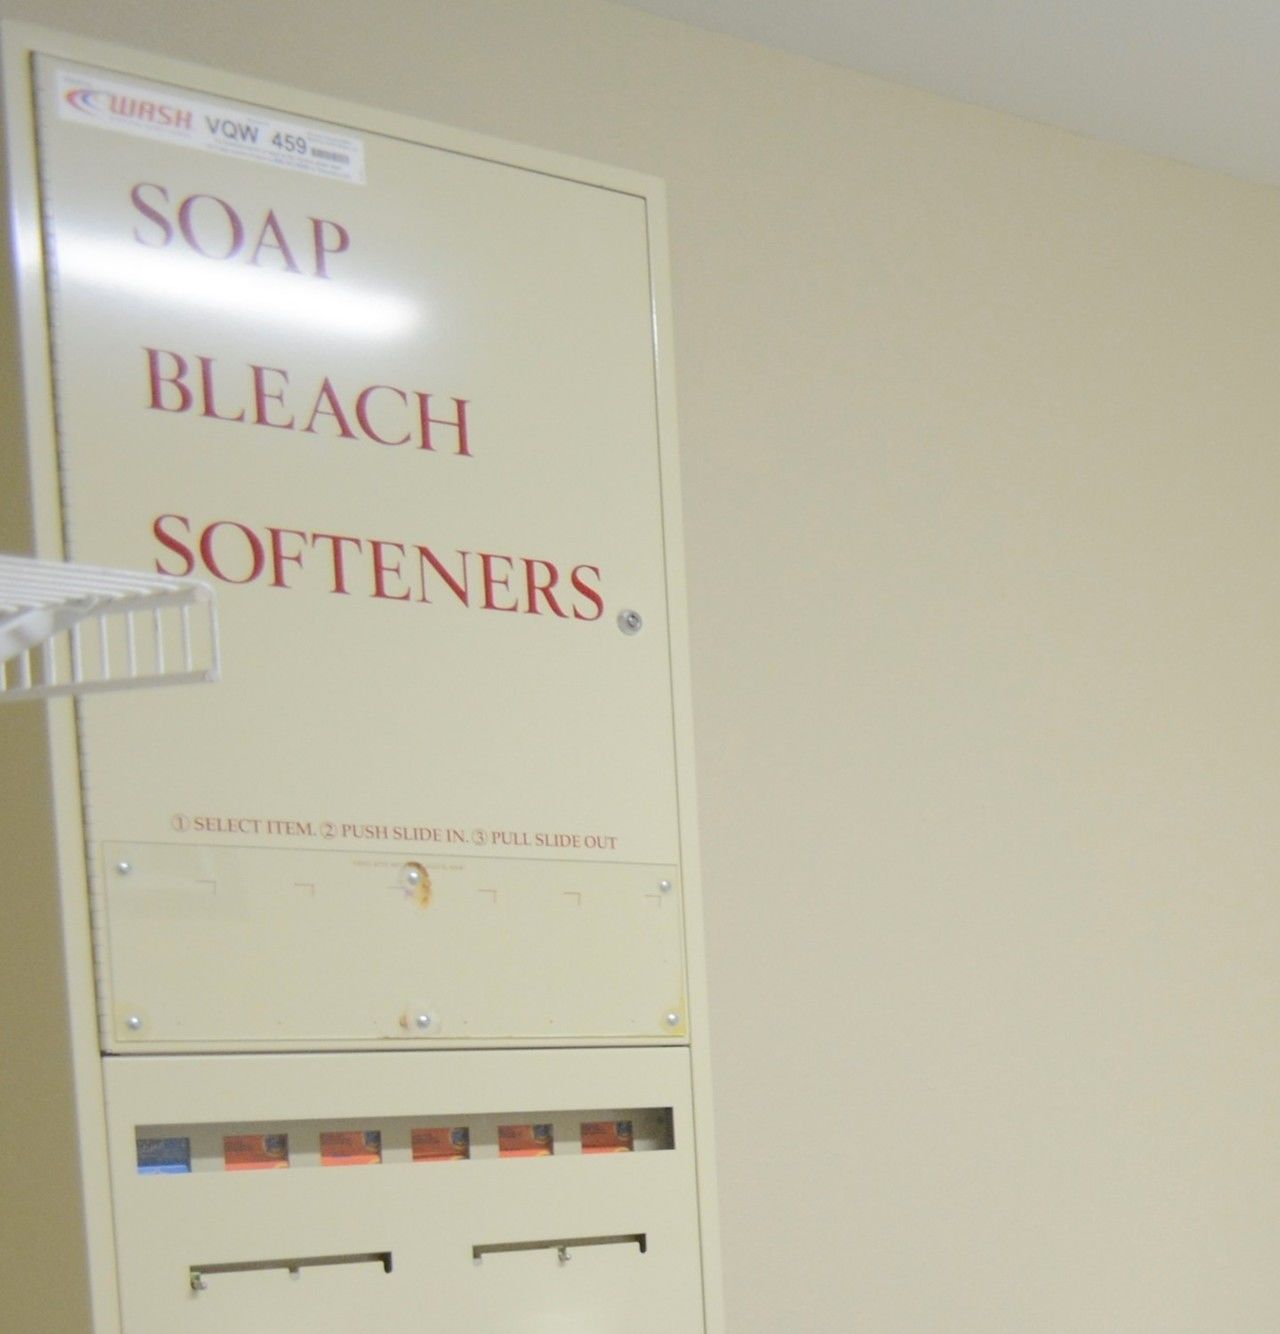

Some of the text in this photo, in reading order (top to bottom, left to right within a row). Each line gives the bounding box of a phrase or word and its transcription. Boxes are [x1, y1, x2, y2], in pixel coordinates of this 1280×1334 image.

[110, 95, 307, 155] WASH VQW 459
[130, 182, 350, 279] SOAP
[143, 347, 473, 457] BLEACH
[153, 514, 605, 622] SOFTENERS
[195, 817, 262, 833] SELECT
[267, 821, 316, 836] ITEM.
[342, 824, 389, 839] PUSH
[393, 827, 442, 842] SLIDE
[492, 832, 532, 846] PULL
[536, 834, 583, 848] SLIDE
[584, 835, 618, 850] OUT
